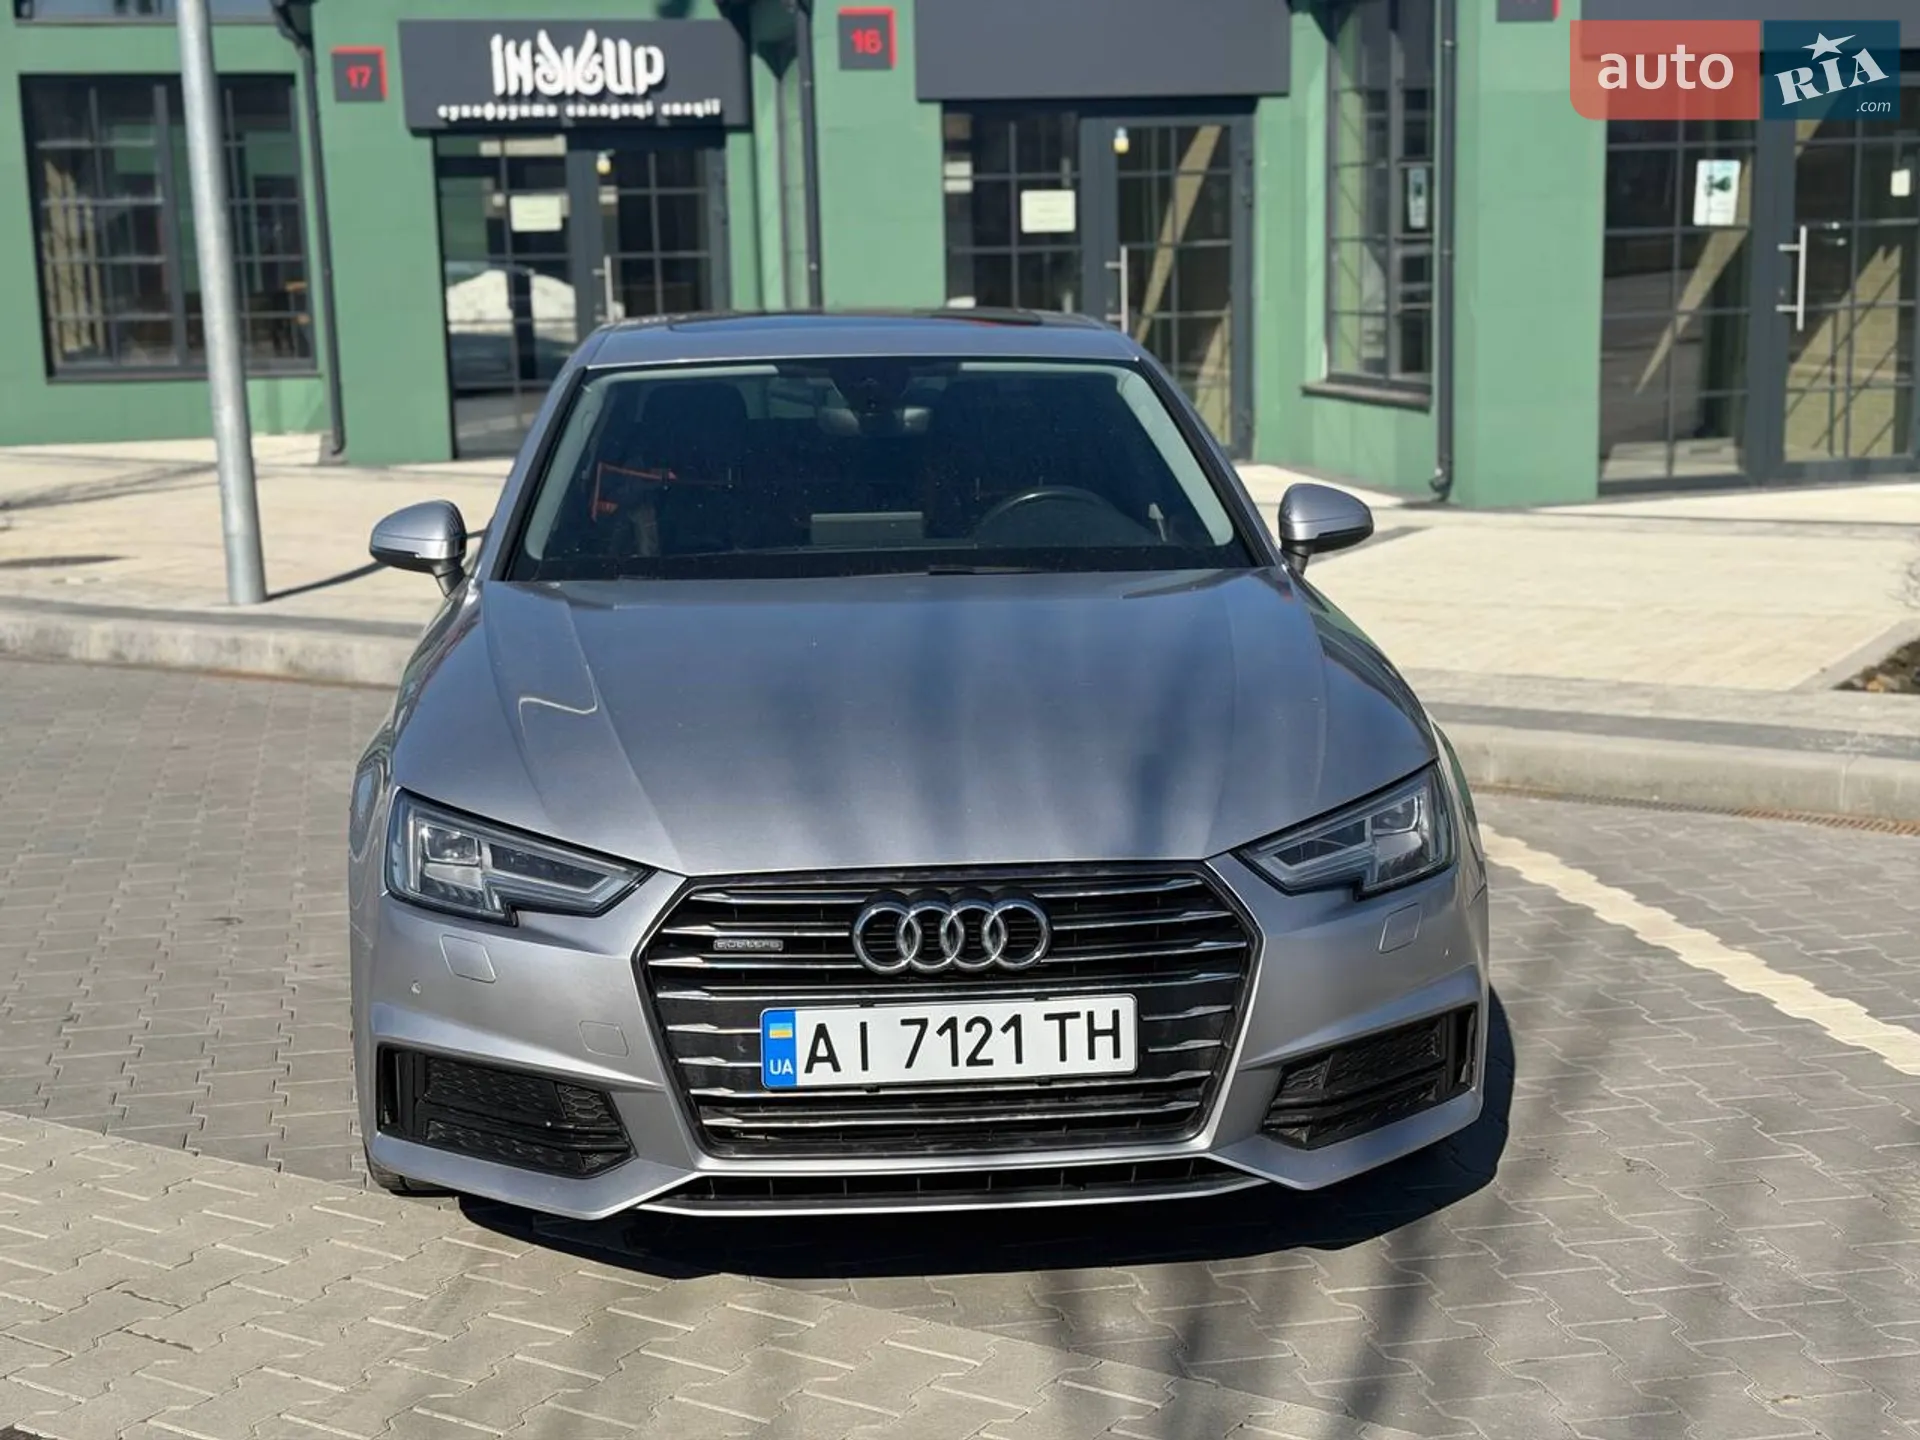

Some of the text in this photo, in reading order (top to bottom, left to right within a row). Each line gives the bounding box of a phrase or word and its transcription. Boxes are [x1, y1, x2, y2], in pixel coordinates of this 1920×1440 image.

[852, 28, 882, 54] 16
[346, 65, 371, 89] 17
[804, 1009, 1121, 1074] AI 7121 TH
[769, 1060, 793, 1076] UA
